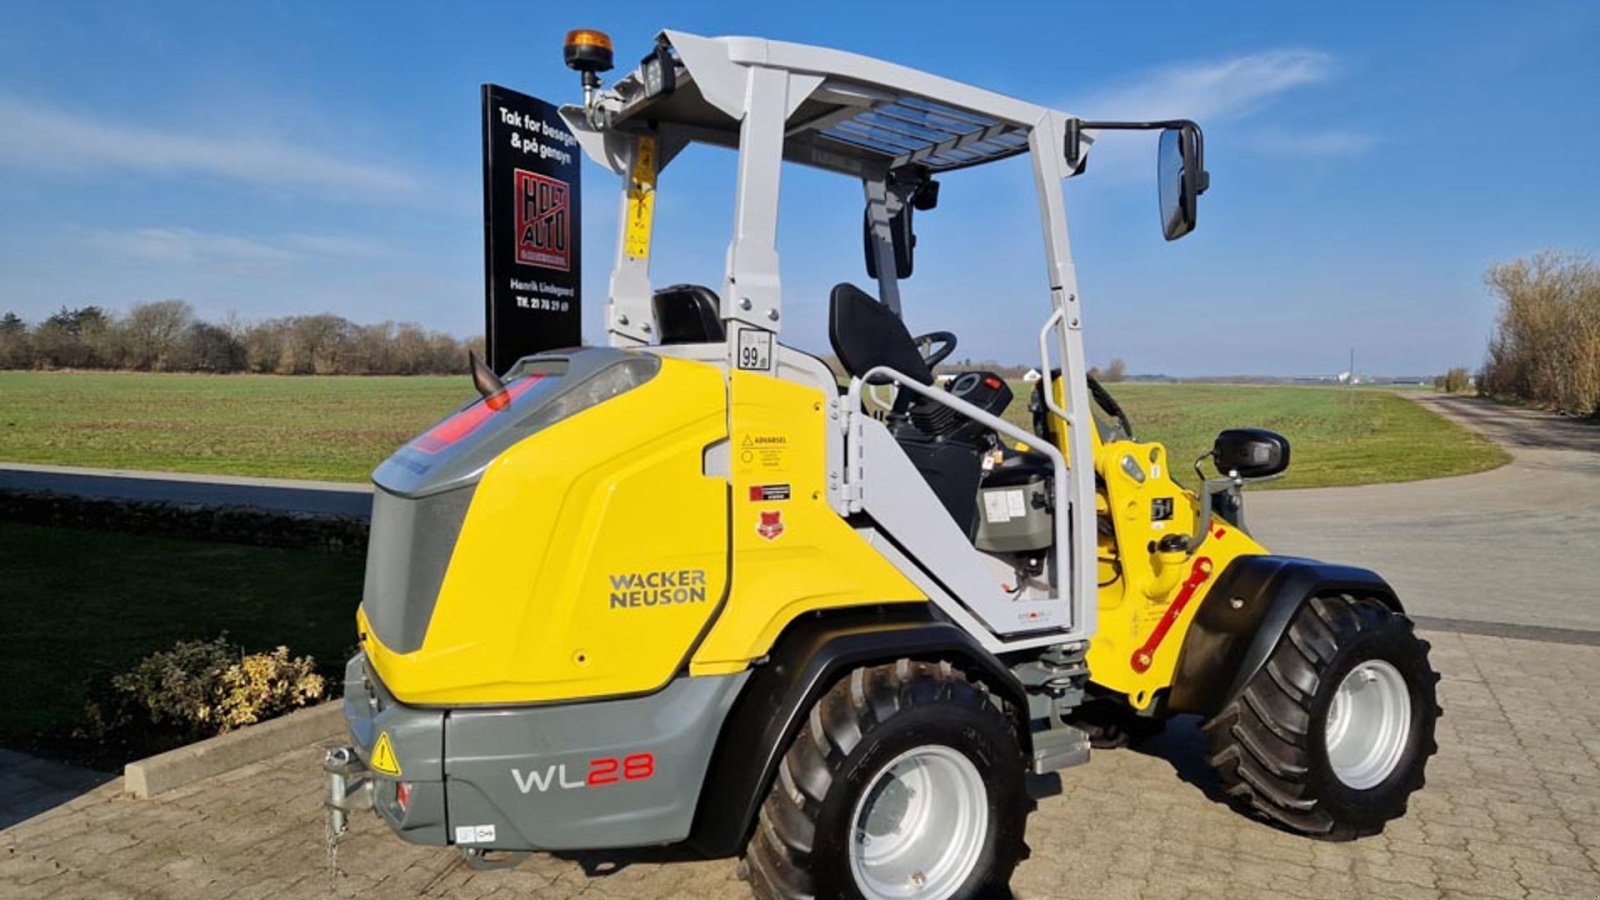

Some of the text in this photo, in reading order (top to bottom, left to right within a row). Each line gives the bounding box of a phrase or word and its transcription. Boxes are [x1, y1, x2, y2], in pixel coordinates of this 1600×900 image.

[499, 106, 522, 128] Tak
[524, 114, 541, 132] for
[510, 132, 572, 165] & på gensyn
[510, 278, 538, 292] Henrik
[742, 346, 759, 367] 99
[609, 569, 706, 591] WACKER
[610, 586, 706, 608] NEUSON
[511, 753, 655, 794] WL28
